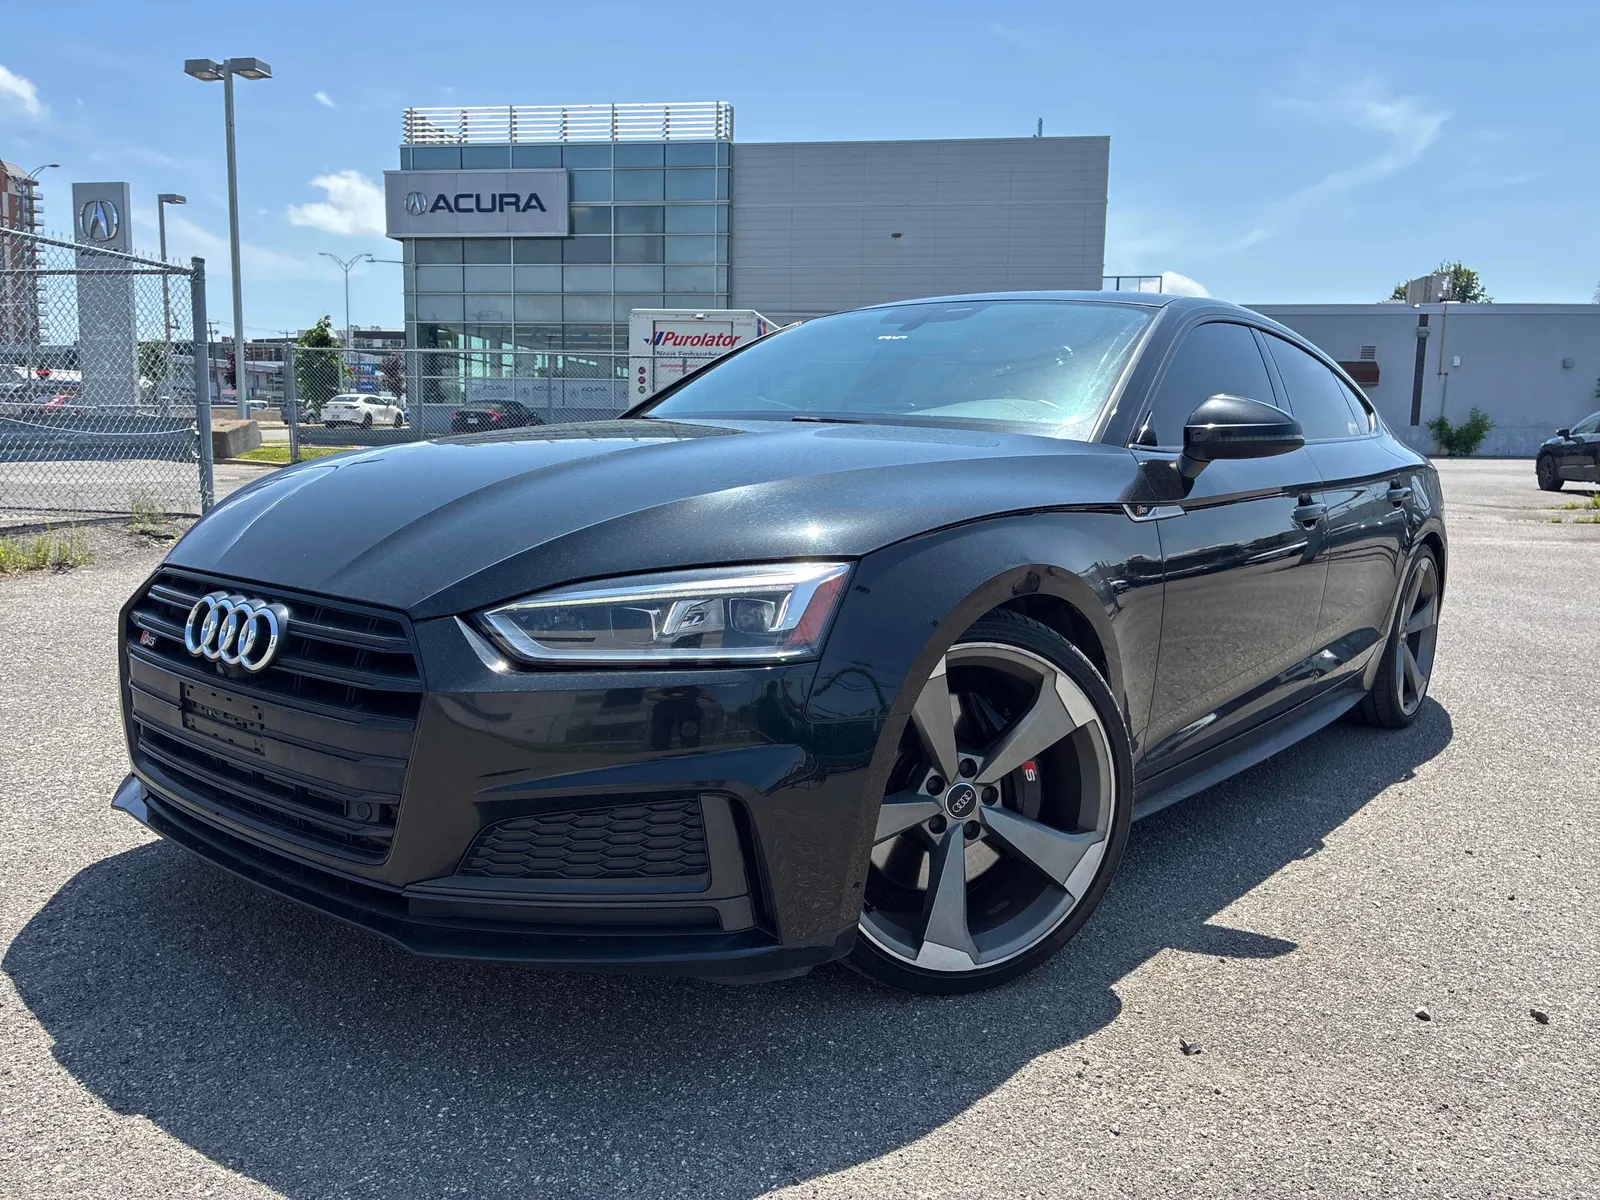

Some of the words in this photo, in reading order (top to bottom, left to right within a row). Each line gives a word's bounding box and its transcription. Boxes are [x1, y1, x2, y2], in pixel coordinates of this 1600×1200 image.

[429, 193, 547, 213] ACURA
[661, 331, 742, 347] Purolator
[142, 633, 156, 646] S5
[1025, 768, 1036, 782] S
